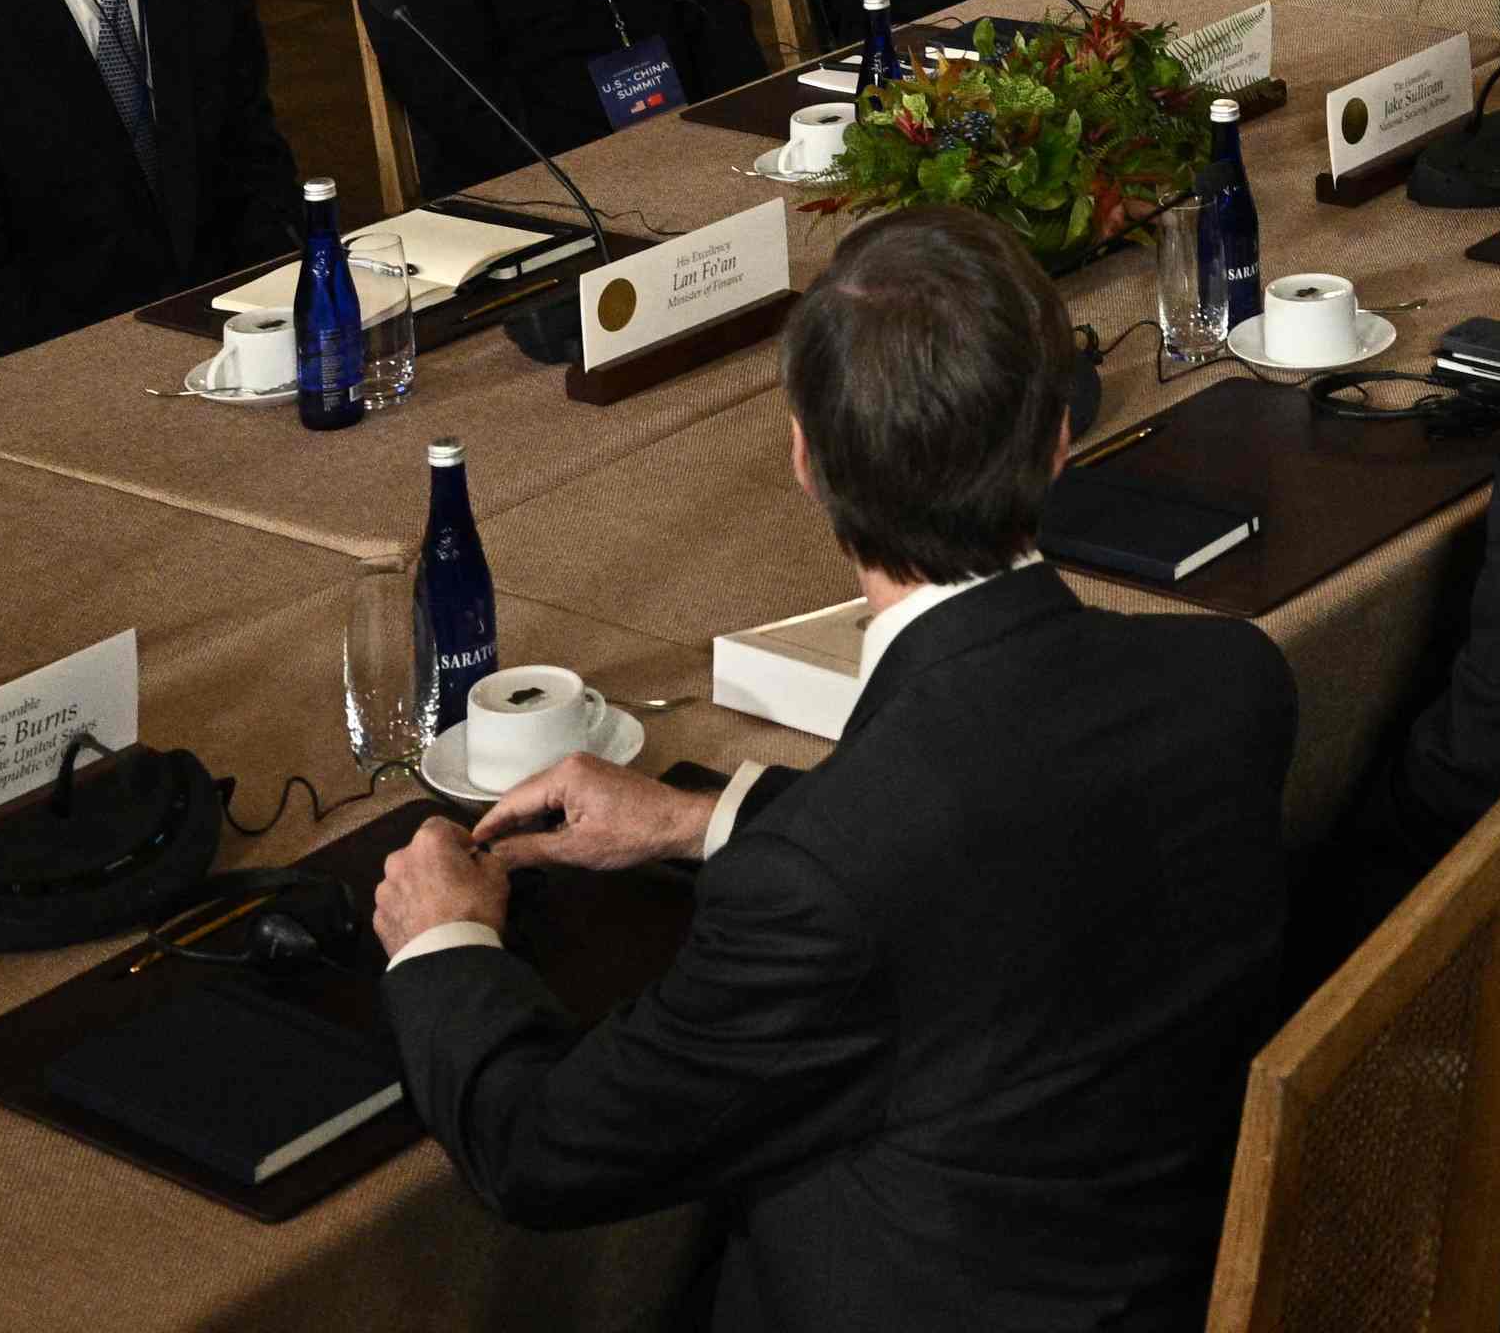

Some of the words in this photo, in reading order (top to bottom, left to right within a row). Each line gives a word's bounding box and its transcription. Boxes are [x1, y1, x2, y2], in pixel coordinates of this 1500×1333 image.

[602, 79, 626, 93] U.S.
[633, 61, 669, 81] CHINA
[617, 75, 661, 100] SUMMIT
[1384, 96, 1403, 118] Jake
[1405, 79, 1444, 107] Sullivan
[673, 270, 697, 292] Lan
[702, 256, 737, 281] Fo'an
[14, 702, 78, 745] Burns
[13, 731, 59, 765] United
[44, 748, 60, 770] of
